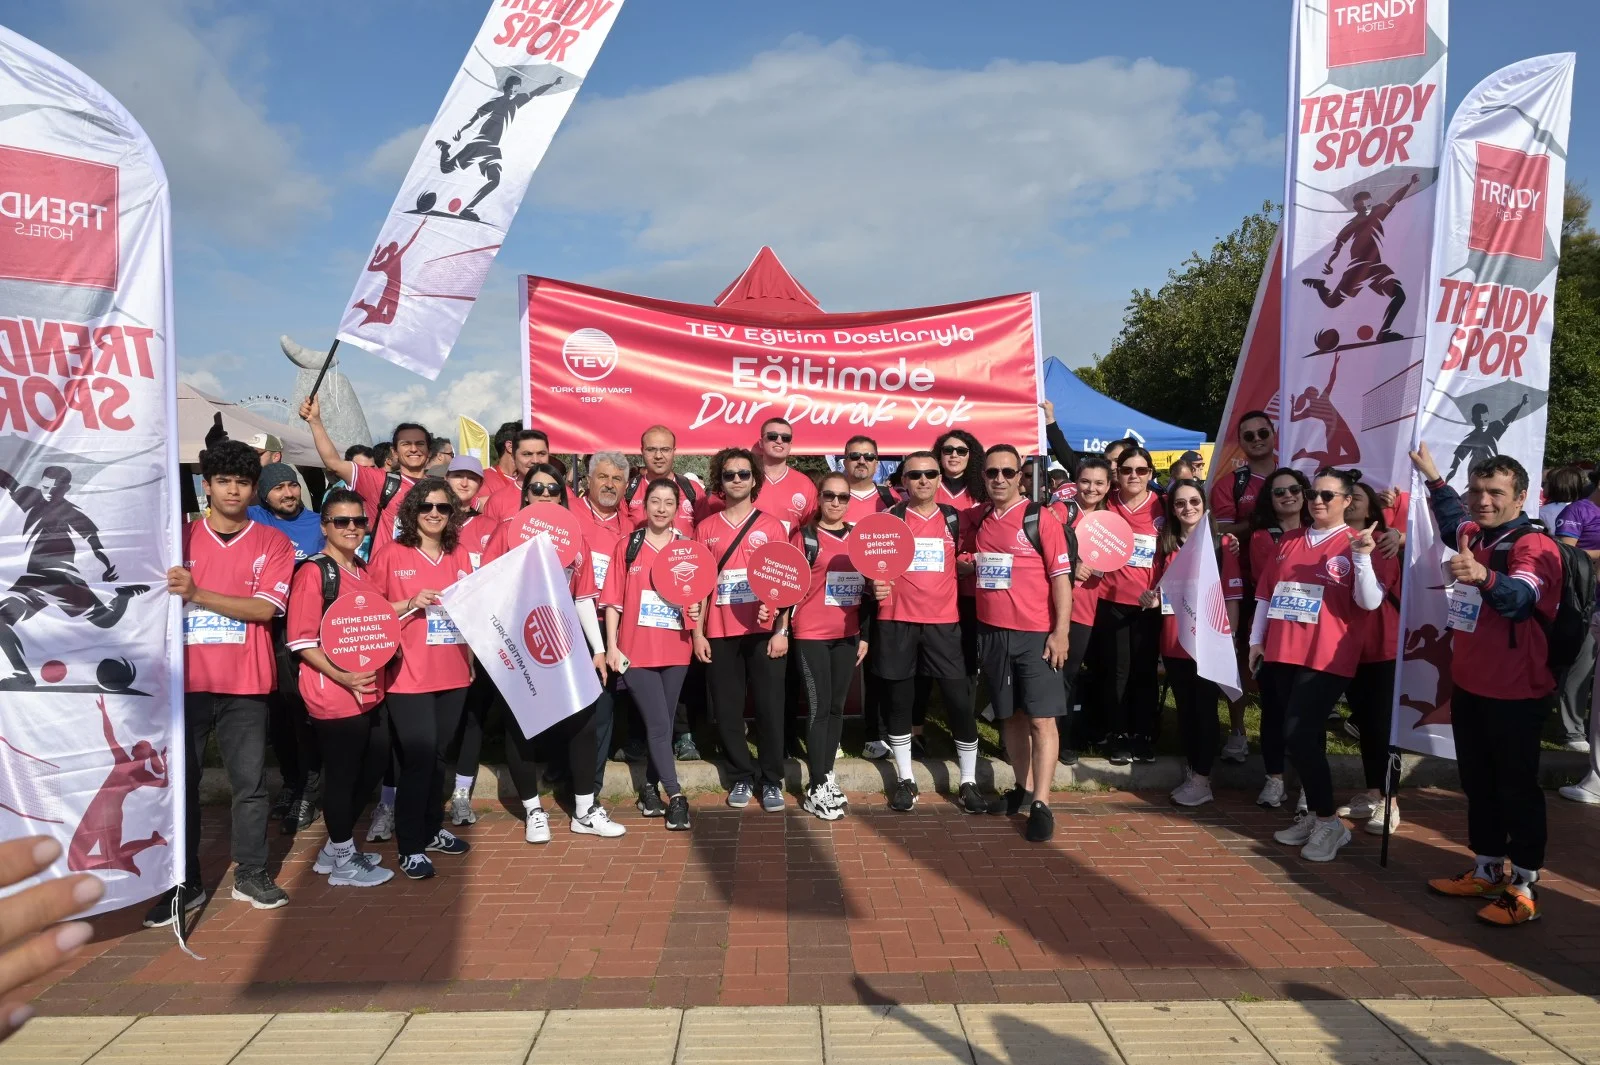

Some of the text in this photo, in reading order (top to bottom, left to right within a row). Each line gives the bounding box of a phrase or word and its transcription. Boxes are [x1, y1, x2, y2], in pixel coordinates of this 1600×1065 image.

[1334, 0, 1416, 26] TRENDY
[1357, 20, 1394, 34] HOTELS
[493, 12, 580, 62] SPOR
[1300, 84, 1436, 135] TRENDY
[1312, 124, 1414, 172] SPOR
[1480, 179, 1541, 212] TRENDY
[1435, 278, 1548, 335] TRENDY
[685, 321, 974, 347] TEV Eğitim Dostlarıyla
[569, 355, 612, 368] TEV
[1440, 327, 1528, 378] SPOR
[731, 355, 936, 397] Eğitimde
[550, 385, 575, 393] TÜRK
[575, 385, 607, 394] EĞİTİM
[688, 392, 974, 430] Dur Durak Yok
[529, 517, 569, 537] Eğitim için
[1092, 519, 1128, 549] Tempomuzu
[560, 537, 571, 546] da
[866, 540, 895, 548] gelecek
[1085, 523, 1127, 556] eğitim aşkımız
[1090, 535, 1112, 555] belirler.
[671, 547, 692, 556] TEV
[864, 548, 899, 556] şekillenir.
[394, 569, 417, 577] TRENDY
[761, 565, 797, 582] eğitim için
[764, 556, 799, 575] Yorgunluk,
[719, 582, 751, 592] 1249
[752, 568, 802, 591] koşunca güzel.
[830, 585, 863, 593] 12489
[1275, 596, 1317, 609] 12487
[331, 613, 391, 626] EĞİTİME DESTEK
[432, 620, 456, 629] 124
[338, 633, 388, 644] KOŞUYORUM,
[343, 624, 382, 635] İÇİN NASIL
[528, 615, 554, 660] TEV
[332, 641, 395, 654] OYNAT BAKALIM!
[489, 614, 538, 697] TÜRK EĞİTİM VAKFI
[497, 648, 515, 671] 1967
